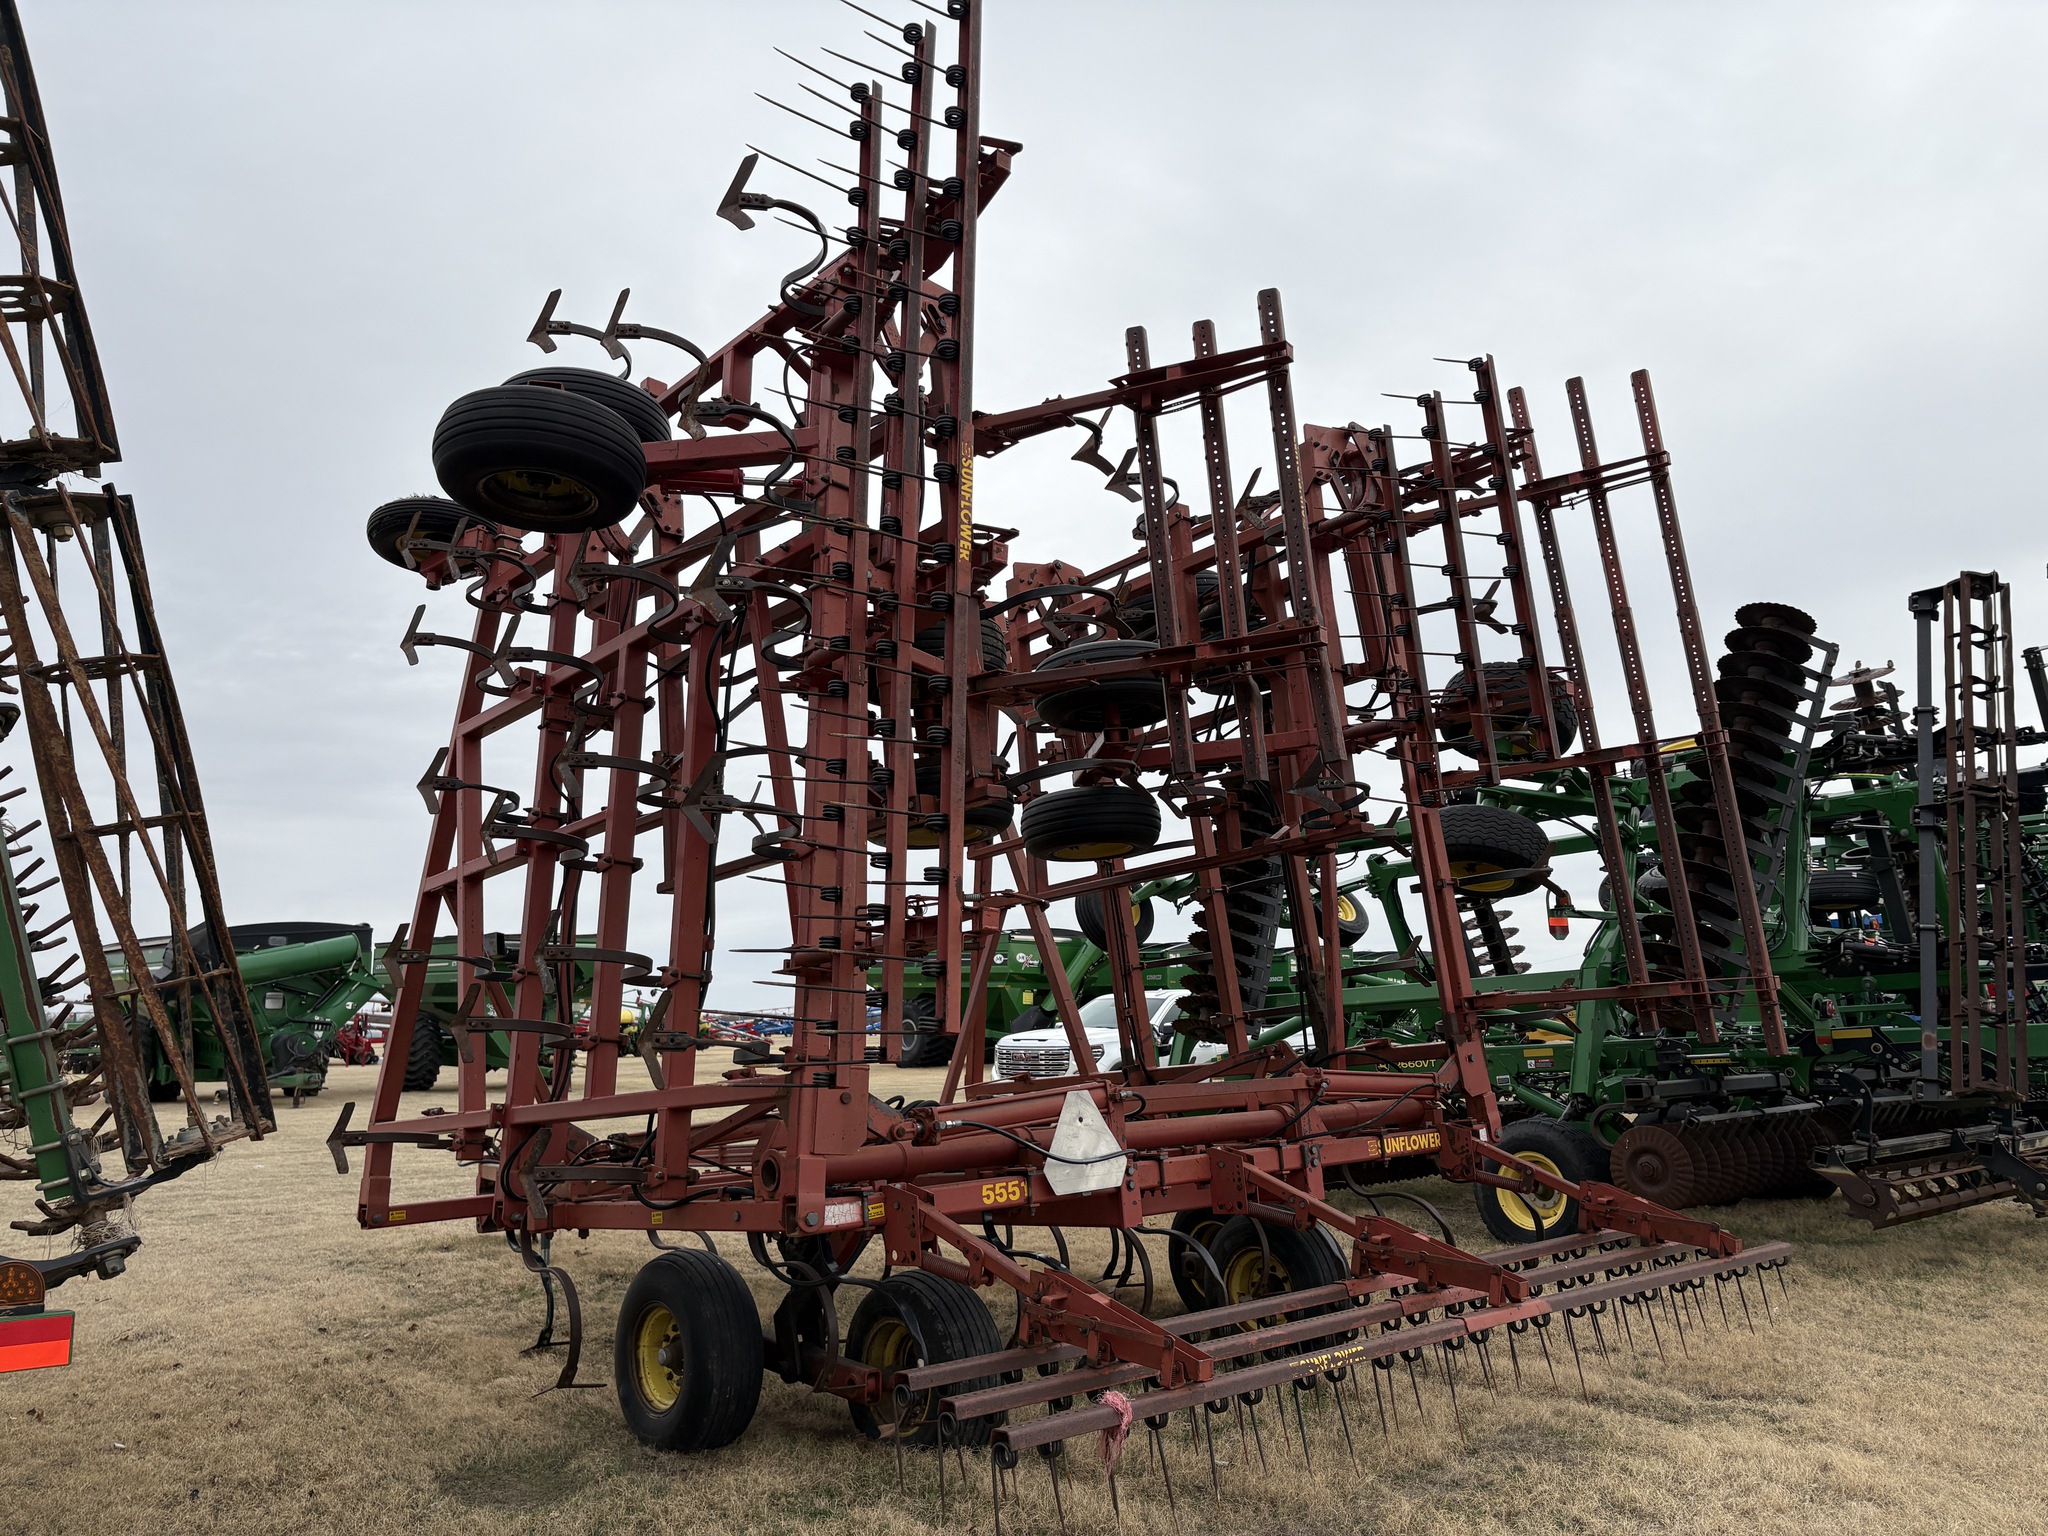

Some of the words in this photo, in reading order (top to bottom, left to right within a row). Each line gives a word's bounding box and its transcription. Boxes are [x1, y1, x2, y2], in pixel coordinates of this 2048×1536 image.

[959, 457, 973, 561] SUNFLOWER
[1377, 1132, 1441, 1155] SUNFLOWER
[982, 1180, 1028, 1205] 5551
